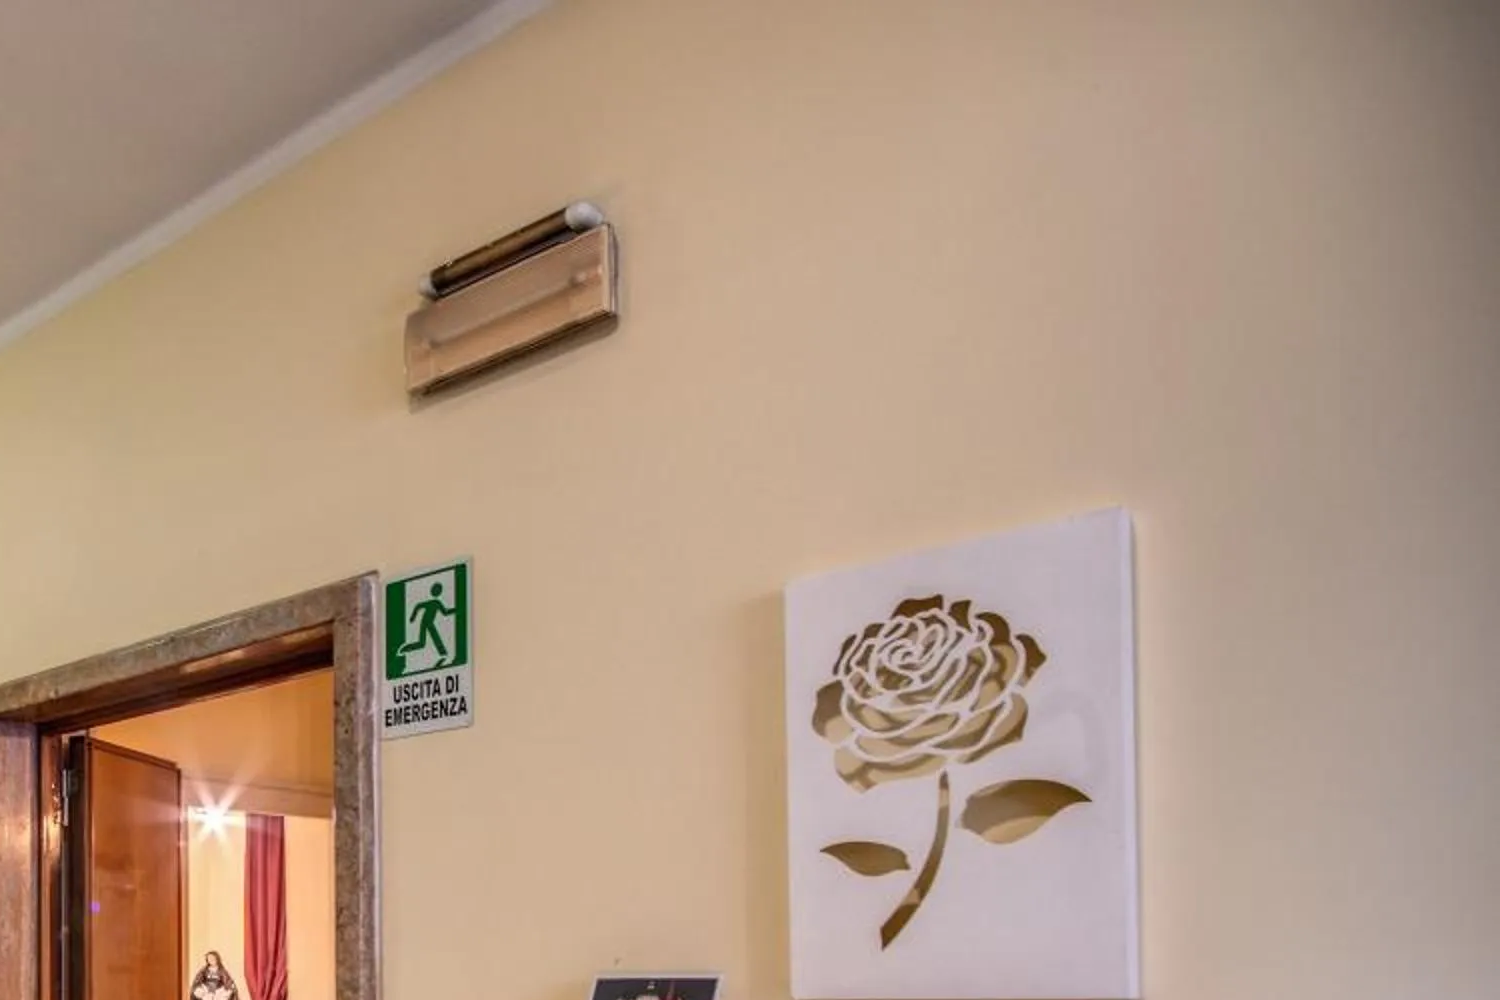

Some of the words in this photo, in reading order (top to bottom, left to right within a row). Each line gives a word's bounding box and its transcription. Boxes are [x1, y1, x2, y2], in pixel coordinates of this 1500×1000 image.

[393, 679, 441, 703] USCITA
[446, 674, 459, 693] DI
[385, 696, 468, 728] EMERGENZA
